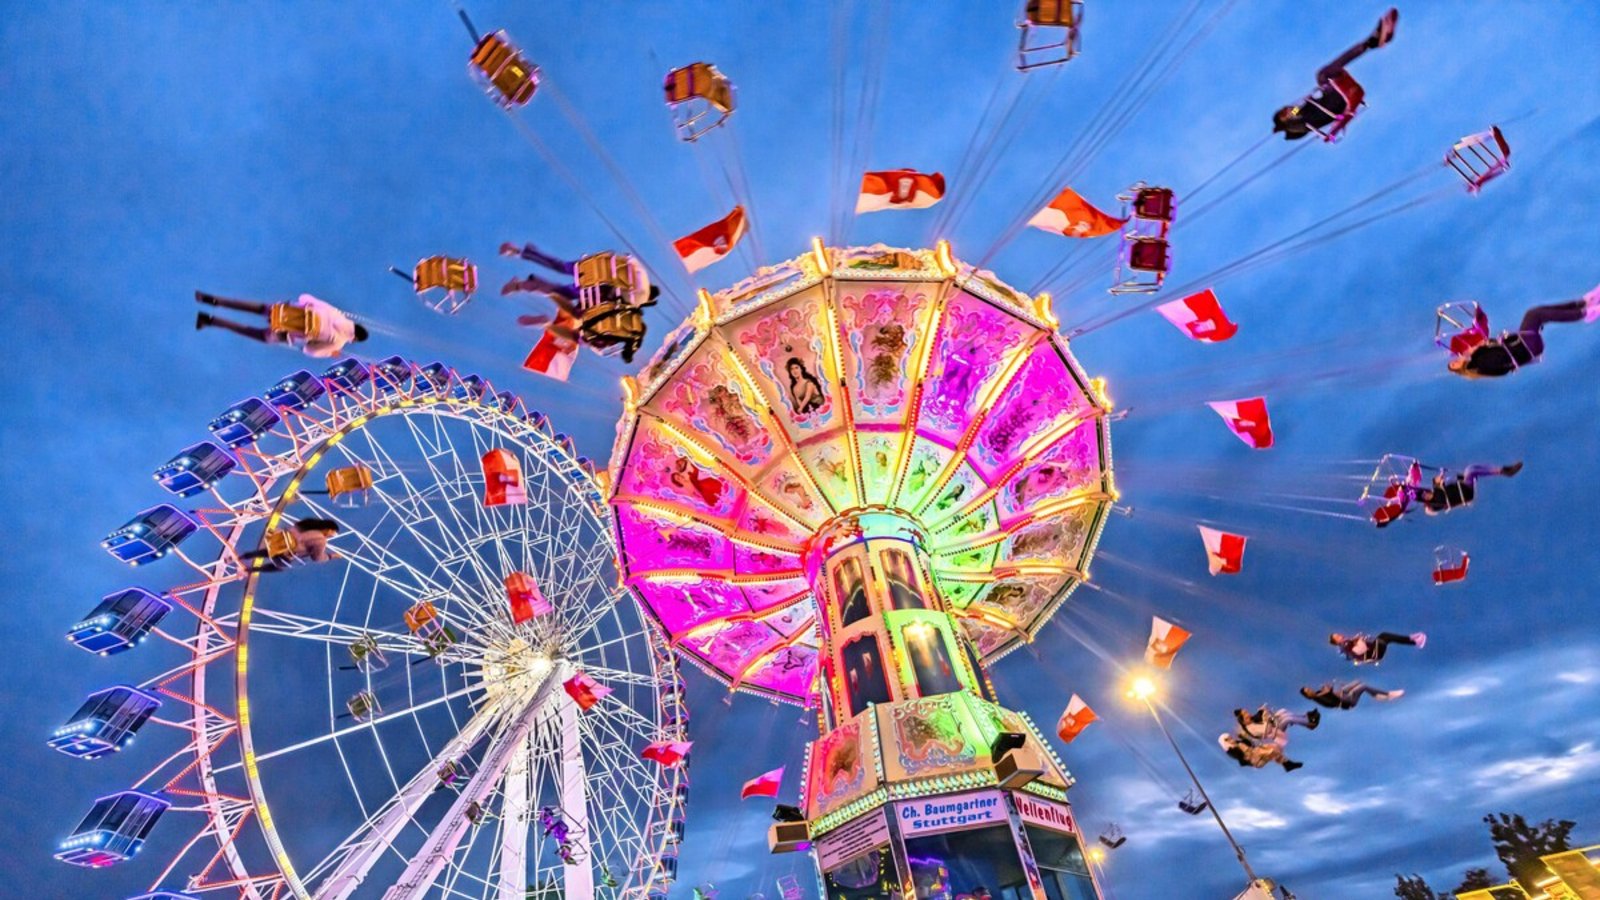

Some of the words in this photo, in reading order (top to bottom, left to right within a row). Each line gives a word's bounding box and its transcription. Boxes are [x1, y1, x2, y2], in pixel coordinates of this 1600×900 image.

[902, 806, 921, 819] Ch.
[924, 797, 998, 816] Baumgartner
[912, 811, 993, 829] Stuttgart
